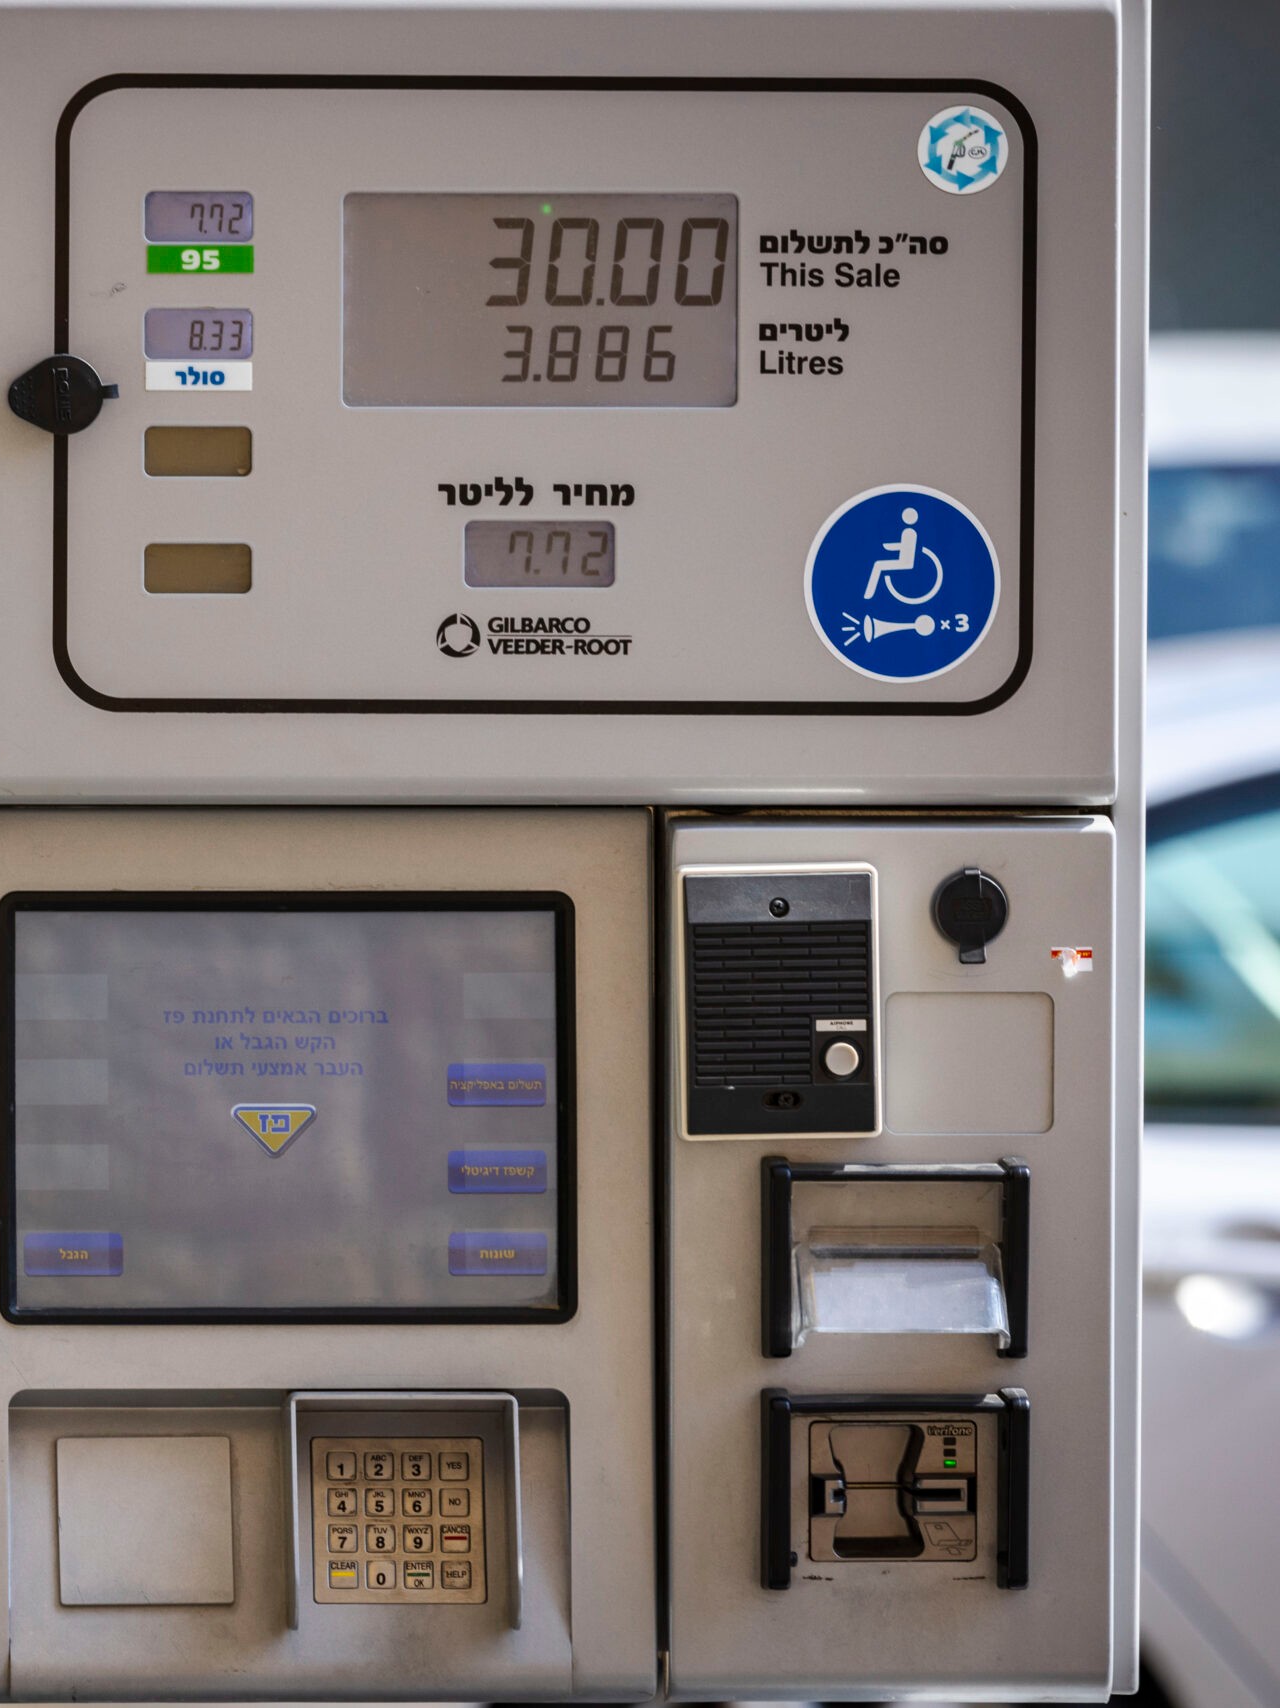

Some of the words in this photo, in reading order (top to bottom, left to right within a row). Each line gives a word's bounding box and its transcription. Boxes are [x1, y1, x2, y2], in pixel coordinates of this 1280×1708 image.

[189, 203, 245, 236] 7.72
[759, 229, 870, 255] לתשלום
[180, 250, 220, 271] 95
[486, 218, 730, 307] 30.00
[759, 262, 825, 288] This
[833, 262, 901, 288] Sale
[188, 321, 244, 353] 8.33
[759, 318, 849, 342] ליטרים
[501, 325, 678, 384] 3.886
[759, 351, 844, 377] Litres
[174, 366, 226, 387] סולר
[438, 477, 534, 507] לליטר
[552, 482, 635, 507] מחיר
[509, 531, 607, 578] 7.72
[487, 617, 591, 633] GILBARCO
[487, 638, 633, 656] VEEDER-ROOT
[163, 1008, 185, 1025] פז
[193, 1006, 256, 1024] לתחנת
[262, 1008, 321, 1024] הבאים
[328, 1008, 388, 1024] ברוכים
[215, 1035, 234, 1051] או
[240, 1032, 289, 1051] הגבל
[297, 1035, 336, 1053] הקש
[184, 1058, 245, 1076] תשלום
[250, 1060, 307, 1076] אמצעי
[314, 1060, 364, 1076] העבר
[450, 1079, 505, 1092] באפליקציה
[508, 1079, 542, 1090] תשלום
[258, 1113, 291, 1133] פז
[460, 1165, 500, 1176] דיגיטלי
[59, 1248, 89, 1261] הגבל
[480, 1249, 516, 1259] שונות
[337, 1465, 344, 1475] 1
[375, 1464, 383, 1475] 2
[412, 1465, 421, 1476] 3
[337, 1501, 346, 1512] 4
[375, 1501, 384, 1512] 5
[413, 1501, 422, 1512] 6
[449, 1498, 461, 1506] NO
[338, 1537, 347, 1548] 7
[376, 1537, 385, 1548] 8
[414, 1537, 423, 1549] 9
[406, 1562, 431, 1570] ENTER
[446, 1570, 466, 1578] HELP
[377, 1573, 385, 1585] 0
[414, 1579, 424, 1587] OK
